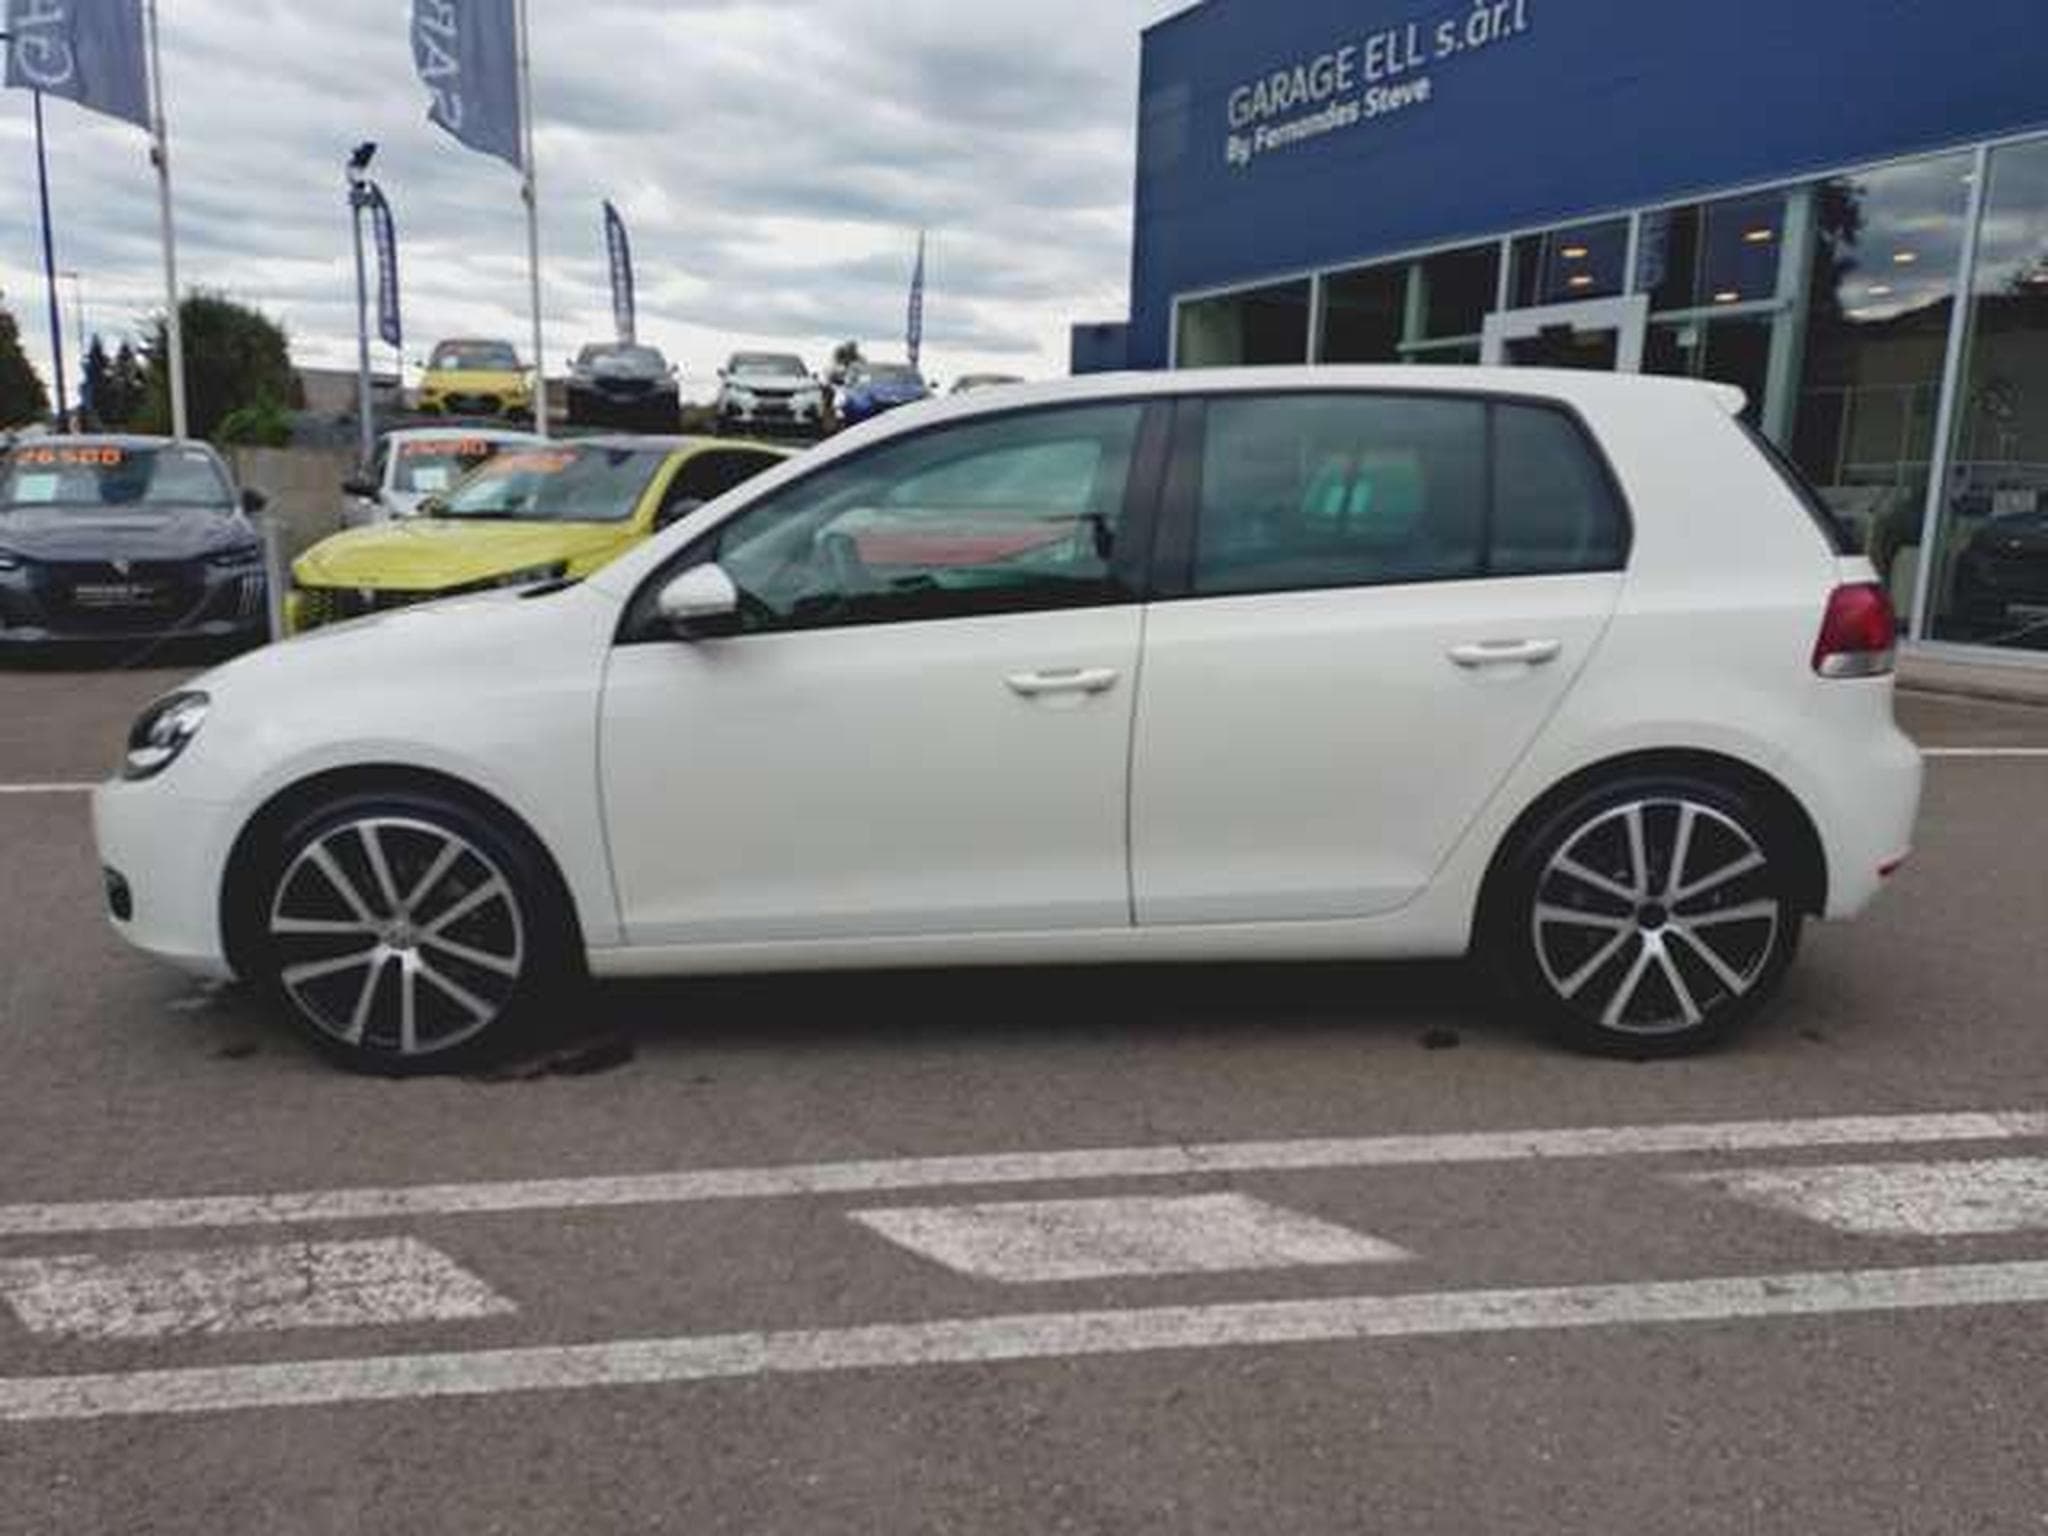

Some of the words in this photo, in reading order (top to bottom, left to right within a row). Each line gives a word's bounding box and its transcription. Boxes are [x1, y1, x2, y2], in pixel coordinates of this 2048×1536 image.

[1226, 133, 1251, 168] By
[1254, 99, 1361, 152] Fernandes
[1364, 76, 1431, 118] Steve
[1227, 45, 1356, 129] GARAGE
[1364, 22, 1426, 82] ELL
